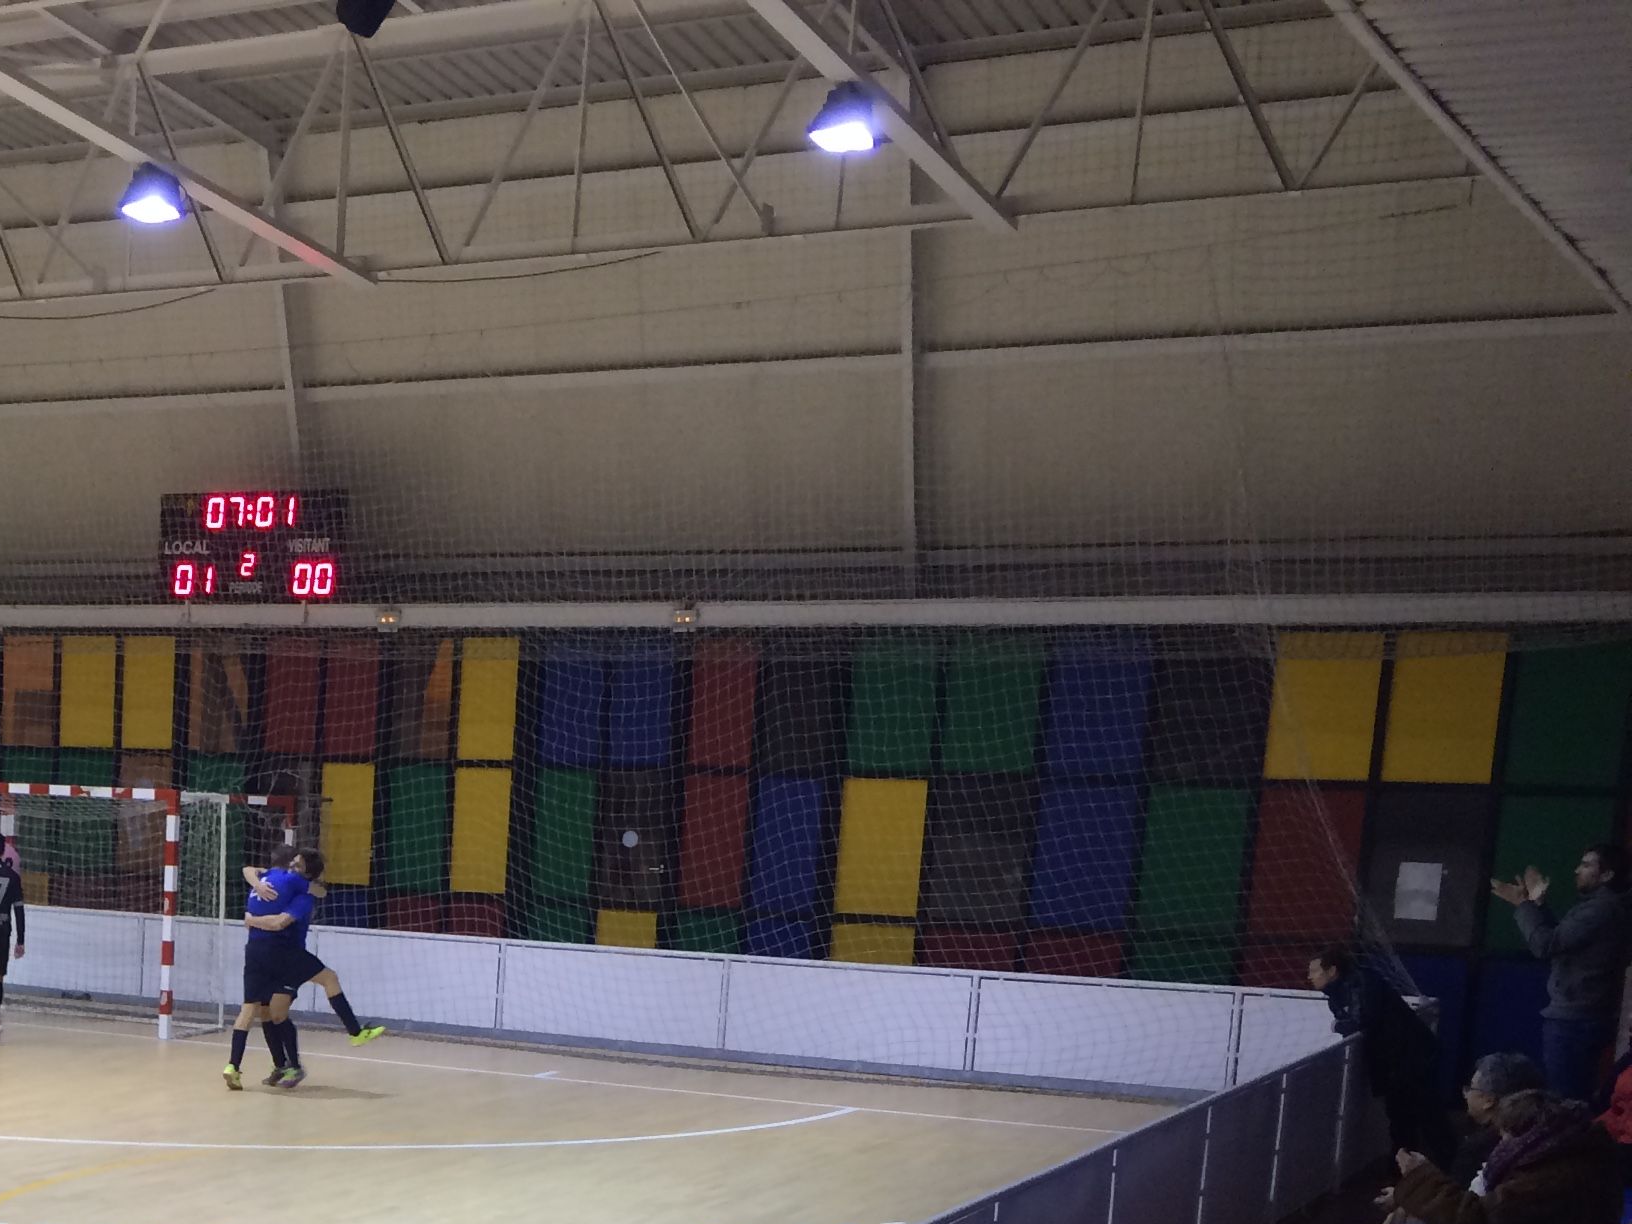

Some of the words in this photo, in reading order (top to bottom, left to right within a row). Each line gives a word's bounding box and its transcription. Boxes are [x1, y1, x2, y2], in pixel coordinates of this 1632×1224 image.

[206, 496, 295, 529] 07:01
[164, 540, 211, 554] LOCAL
[288, 538, 331, 553] VISITANT
[240, 553, 255, 577] 2
[174, 564, 213, 595] 01
[292, 563, 333, 595] 00
